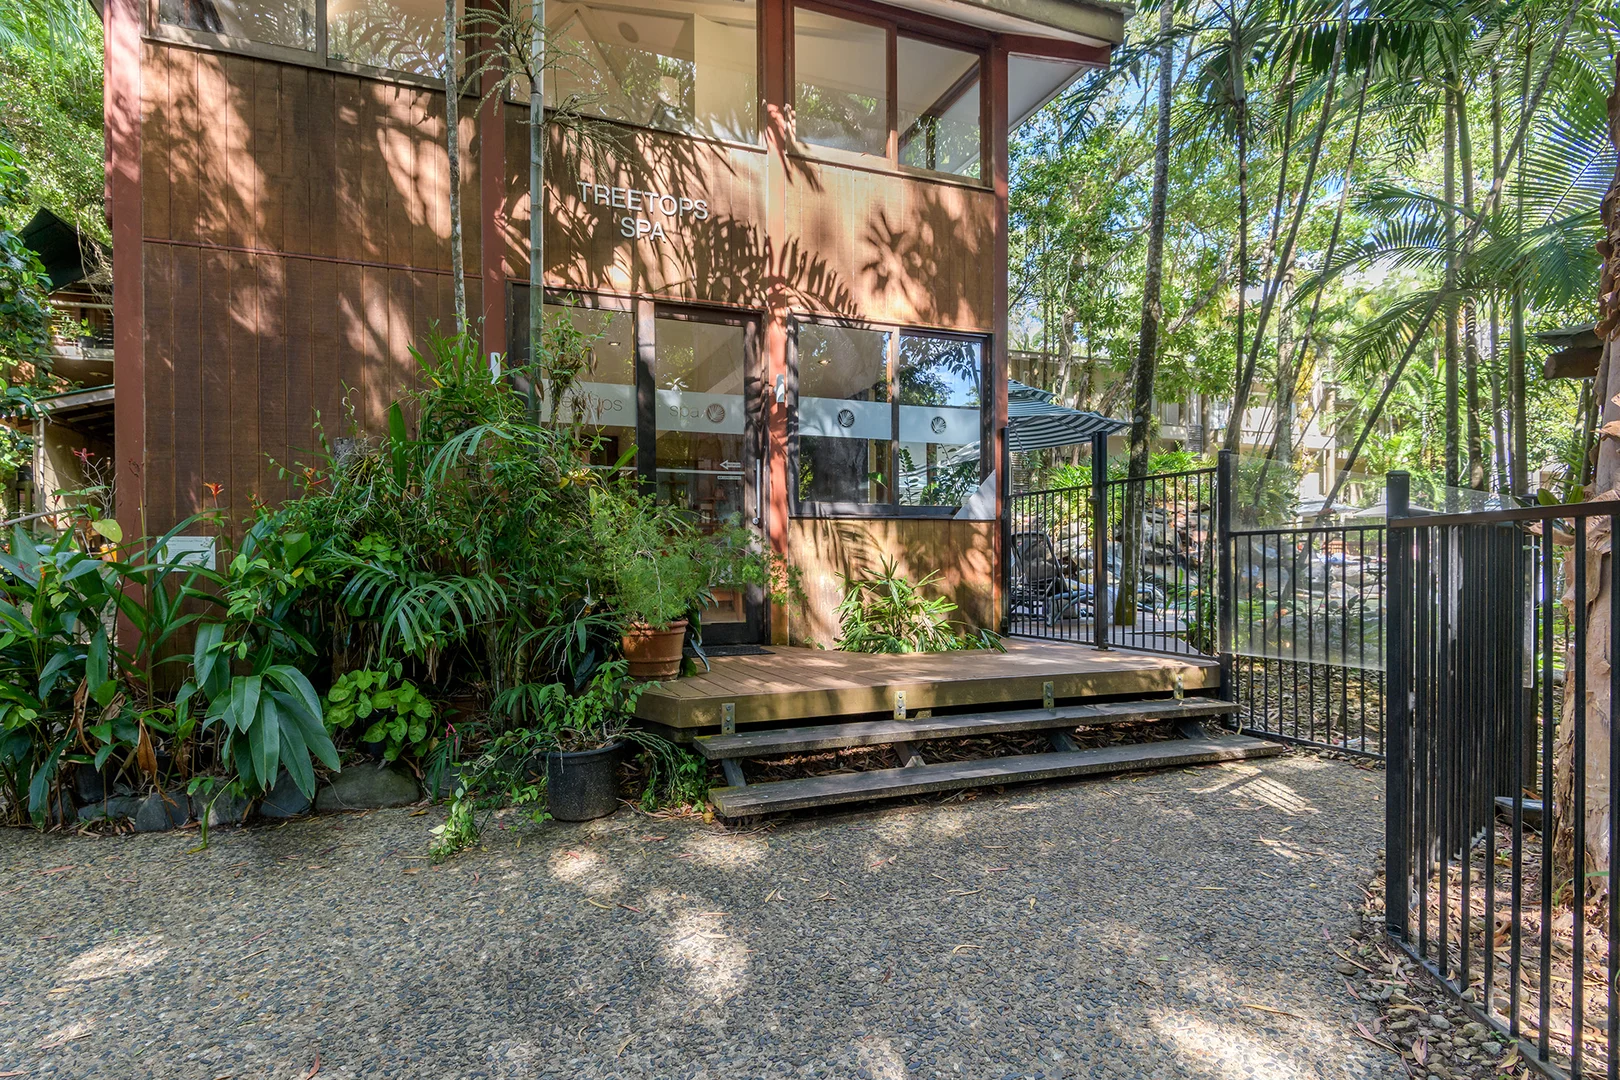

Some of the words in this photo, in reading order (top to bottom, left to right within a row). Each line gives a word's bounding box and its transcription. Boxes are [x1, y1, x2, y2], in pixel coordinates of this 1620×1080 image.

[576, 181, 709, 220] TREETOPS
[620, 216, 667, 243] SPA
[669, 405, 700, 421] spa
